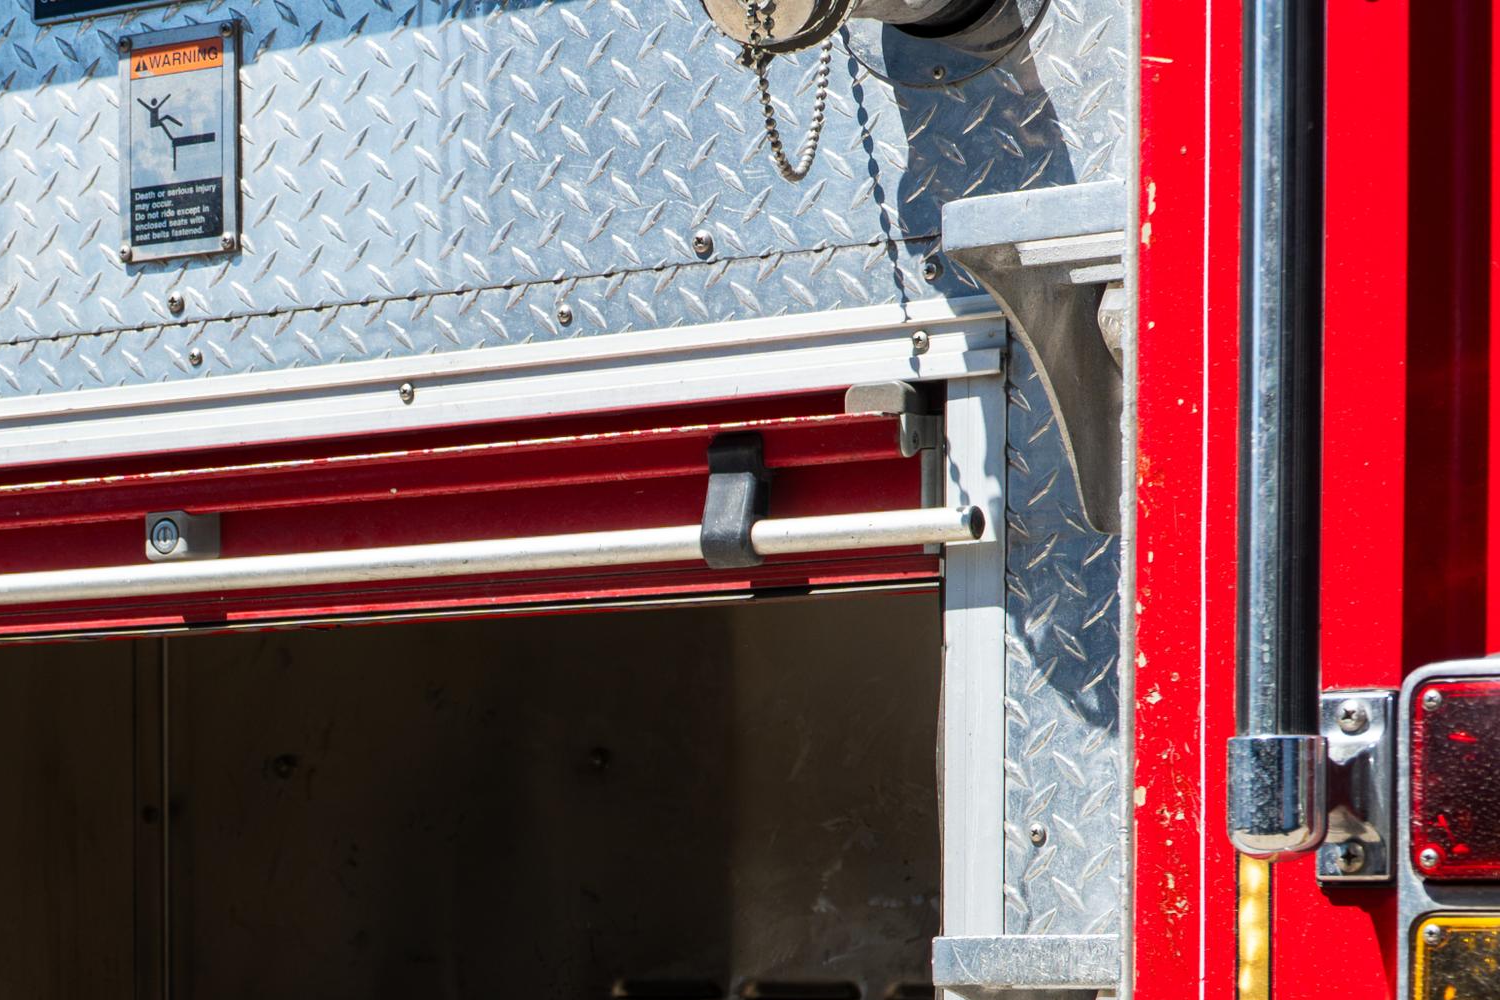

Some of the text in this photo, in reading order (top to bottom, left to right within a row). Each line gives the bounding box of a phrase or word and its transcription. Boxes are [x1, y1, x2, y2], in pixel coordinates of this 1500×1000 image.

[149, 46, 218, 69] WARNING
[135, 184, 216, 200] Death or serious injury
[135, 203, 150, 211] may
[135, 204, 210, 221] Do not ride except in
[135, 215, 205, 231] enclosed seats with
[135, 233, 150, 241] seat
[151, 231, 170, 239] belts
